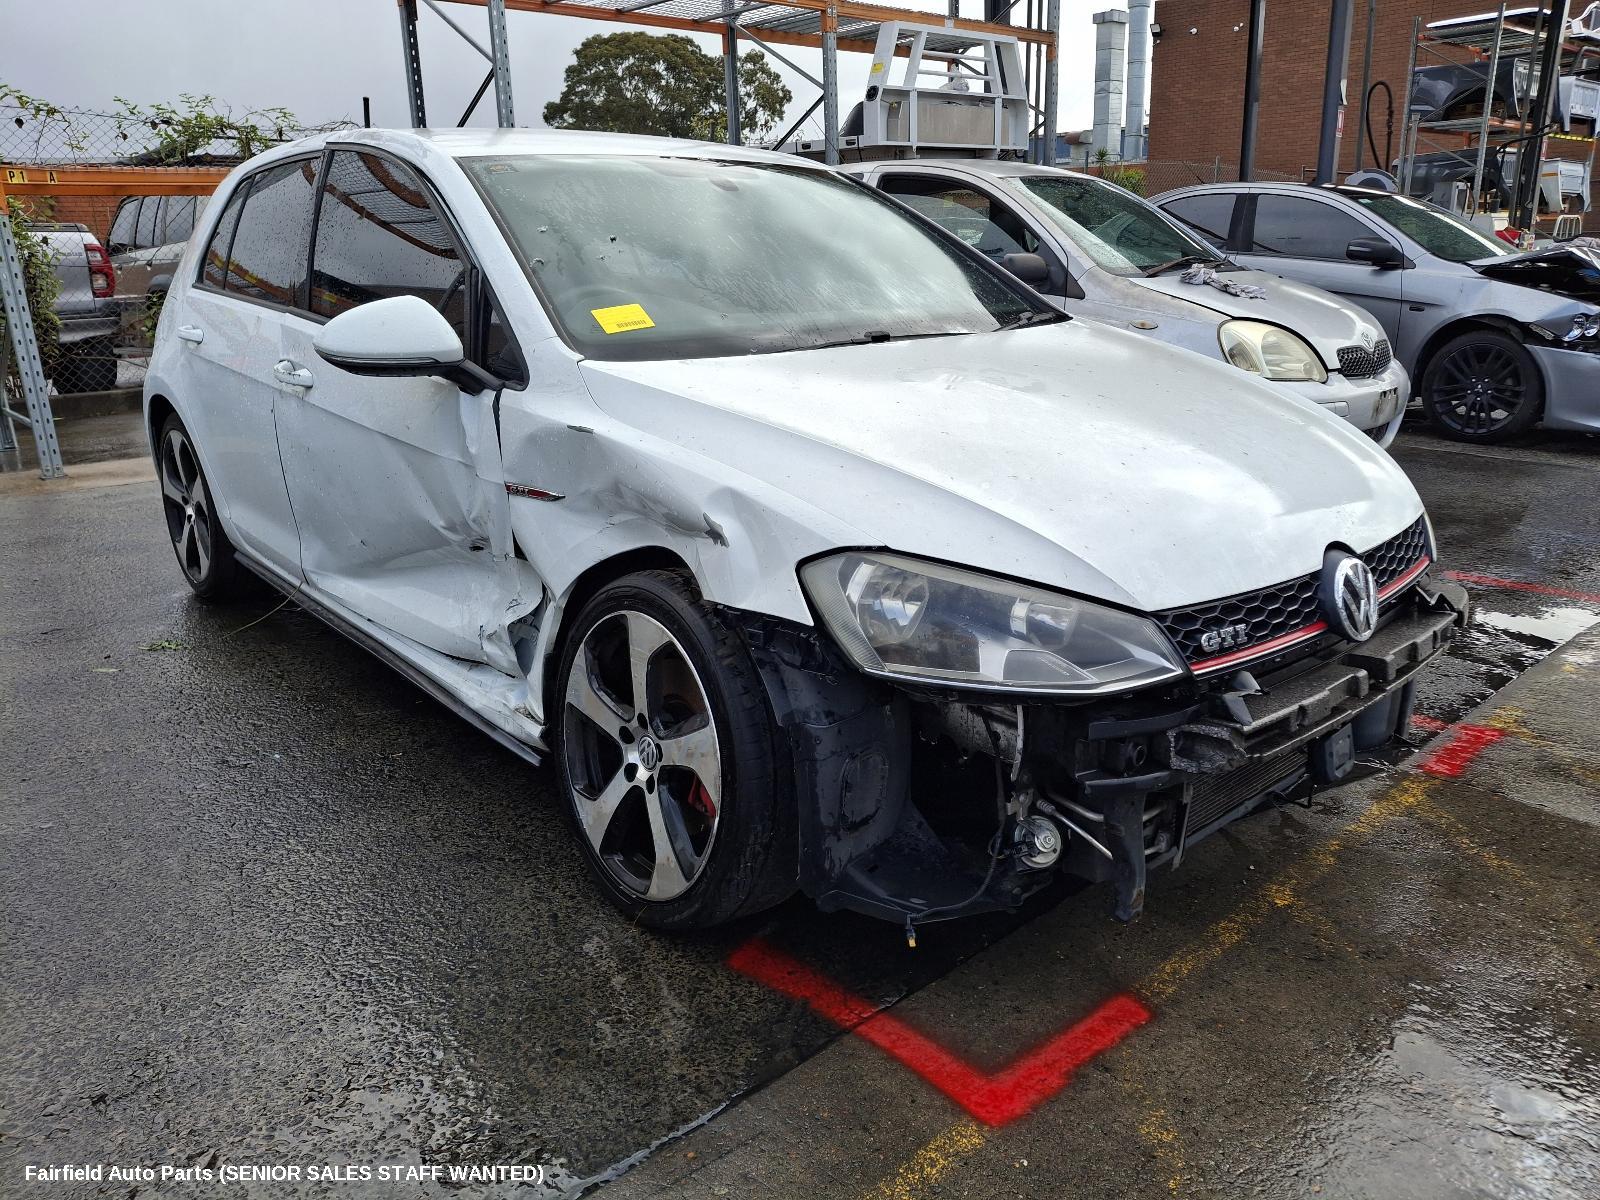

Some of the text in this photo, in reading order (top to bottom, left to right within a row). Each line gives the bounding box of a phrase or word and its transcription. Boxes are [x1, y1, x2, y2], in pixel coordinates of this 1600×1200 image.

[8, 170, 57, 184] P1 A
[1200, 623, 1248, 653] GTI
